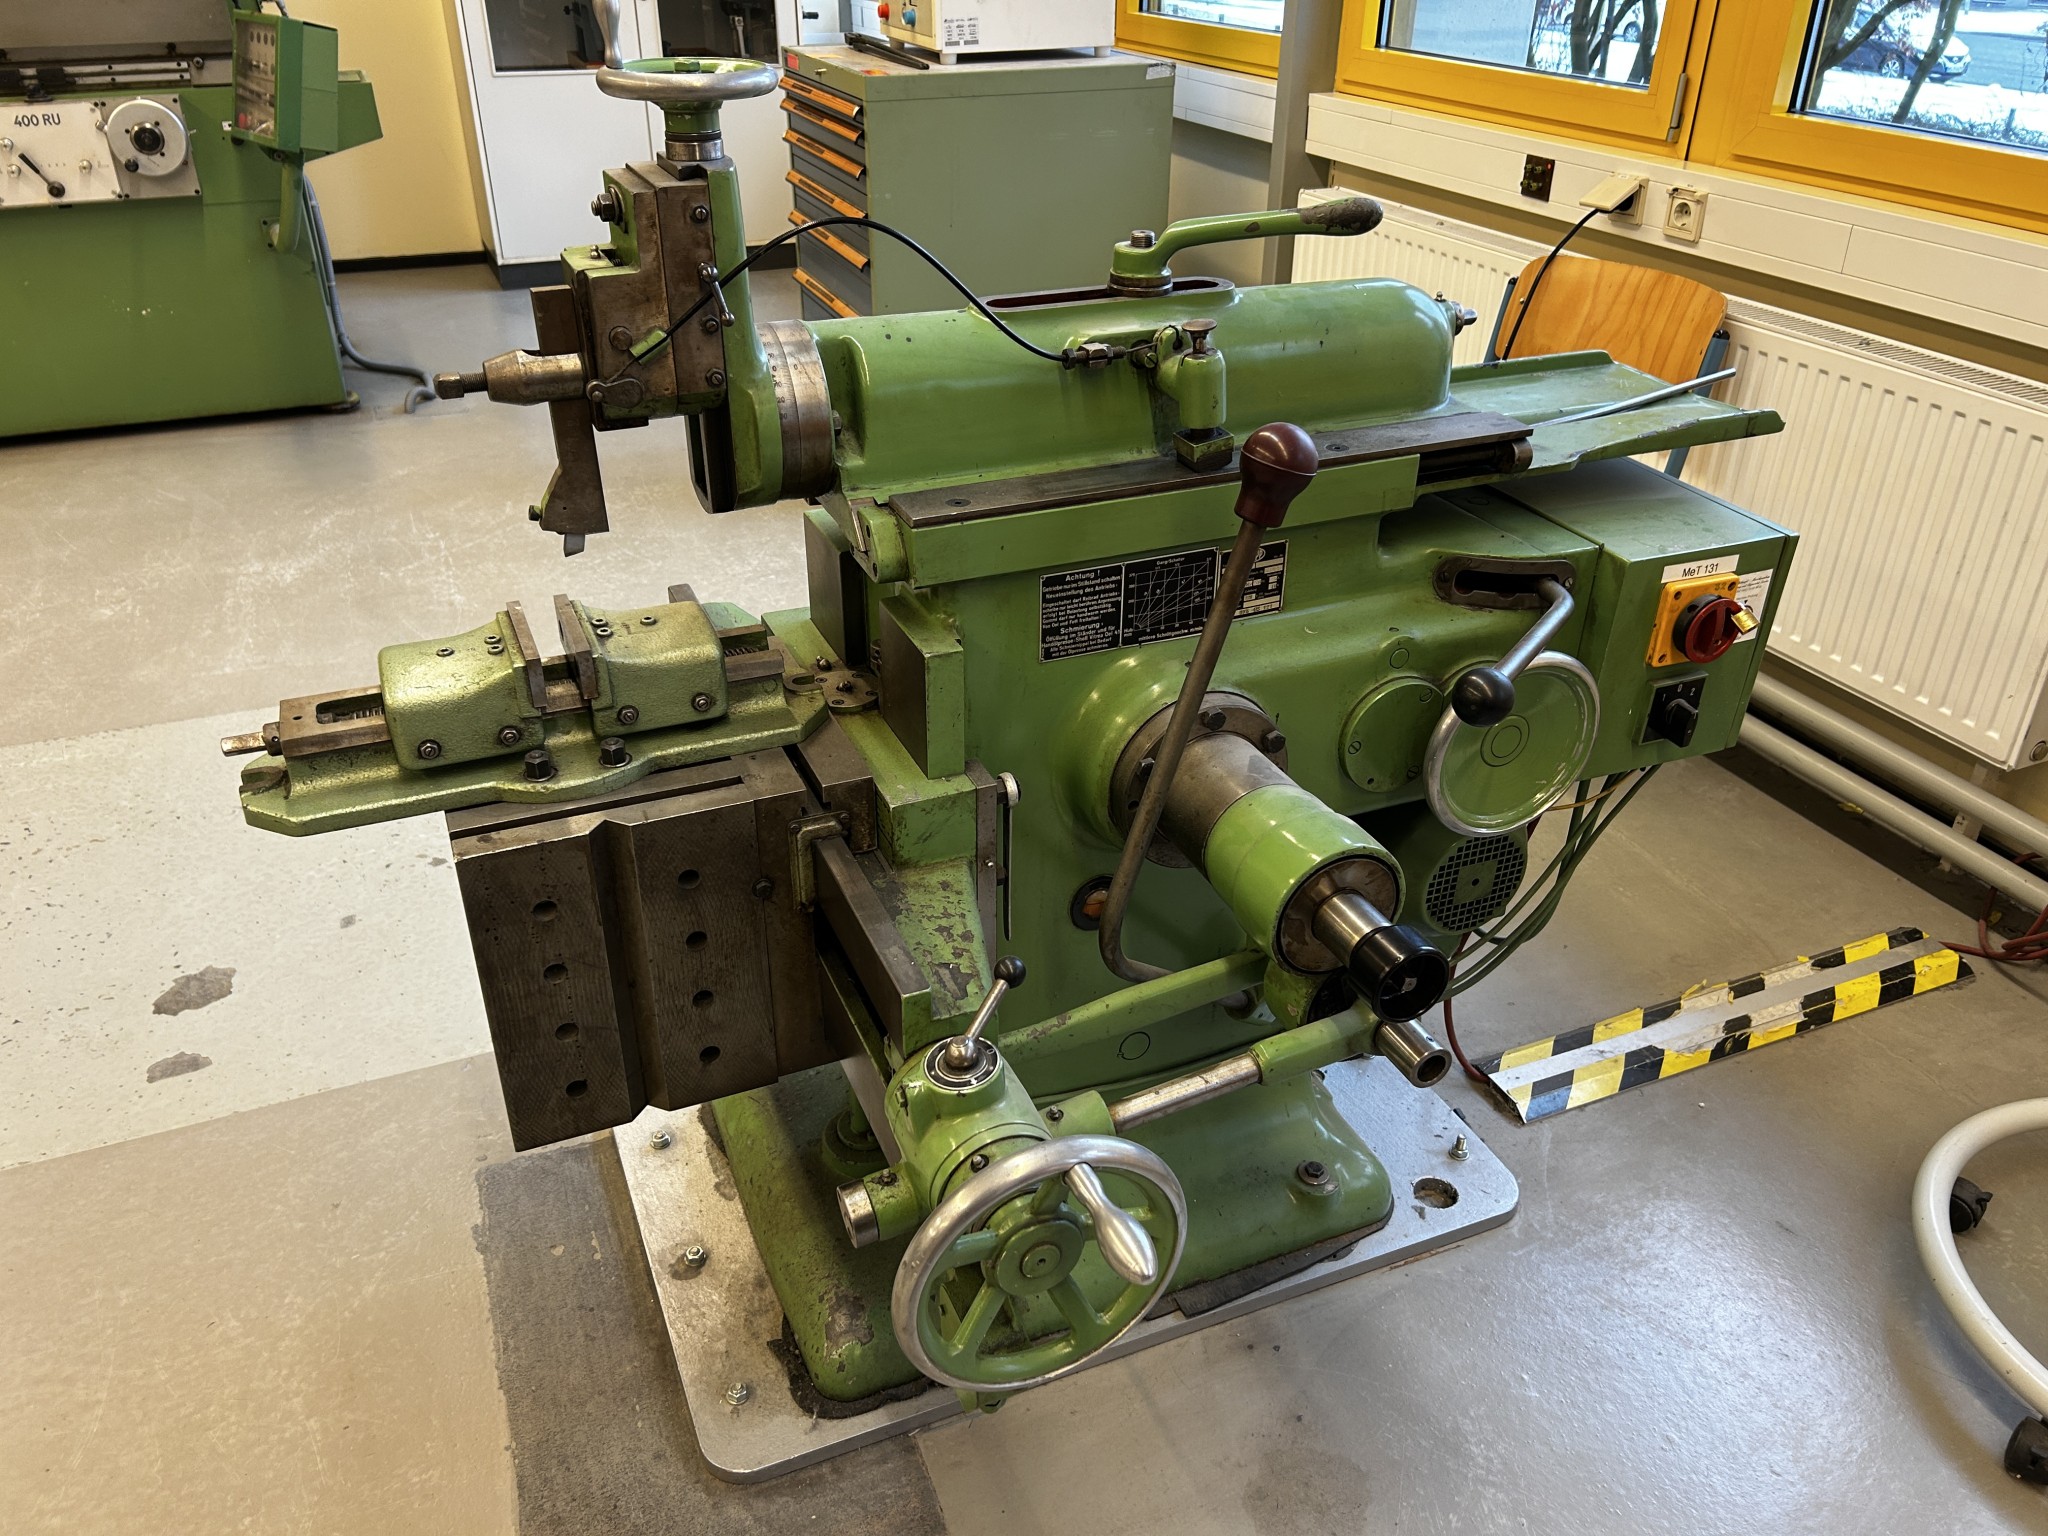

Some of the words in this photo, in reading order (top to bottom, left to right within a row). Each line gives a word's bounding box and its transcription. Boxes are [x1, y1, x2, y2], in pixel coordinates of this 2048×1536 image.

[14, 114, 39, 127] 400
[42, 113, 61, 126] RU
[1682, 565, 1702, 577] MeT
[1704, 562, 1720, 573] 131
[1066, 572, 1094, 581] Achtung
[1677, 683, 1683, 693] 0
[1689, 687, 1696, 696] 2
